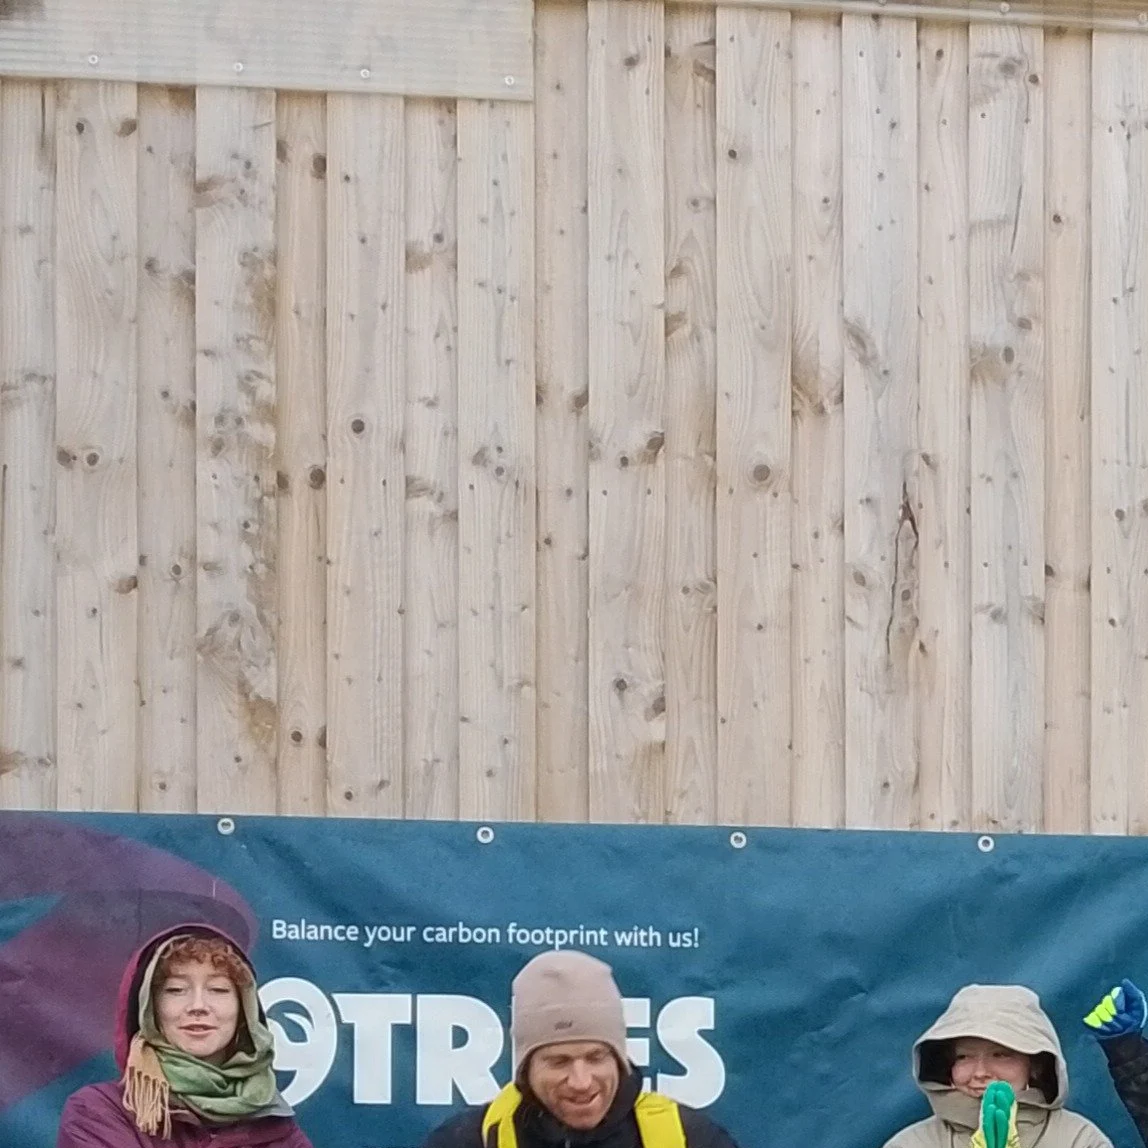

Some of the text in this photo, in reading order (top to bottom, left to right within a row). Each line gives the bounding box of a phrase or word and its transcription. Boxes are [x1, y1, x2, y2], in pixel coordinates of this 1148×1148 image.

[271, 918, 700, 951] Balance your carbon footprint with us!
[258, 976, 726, 1110] 9TRS
